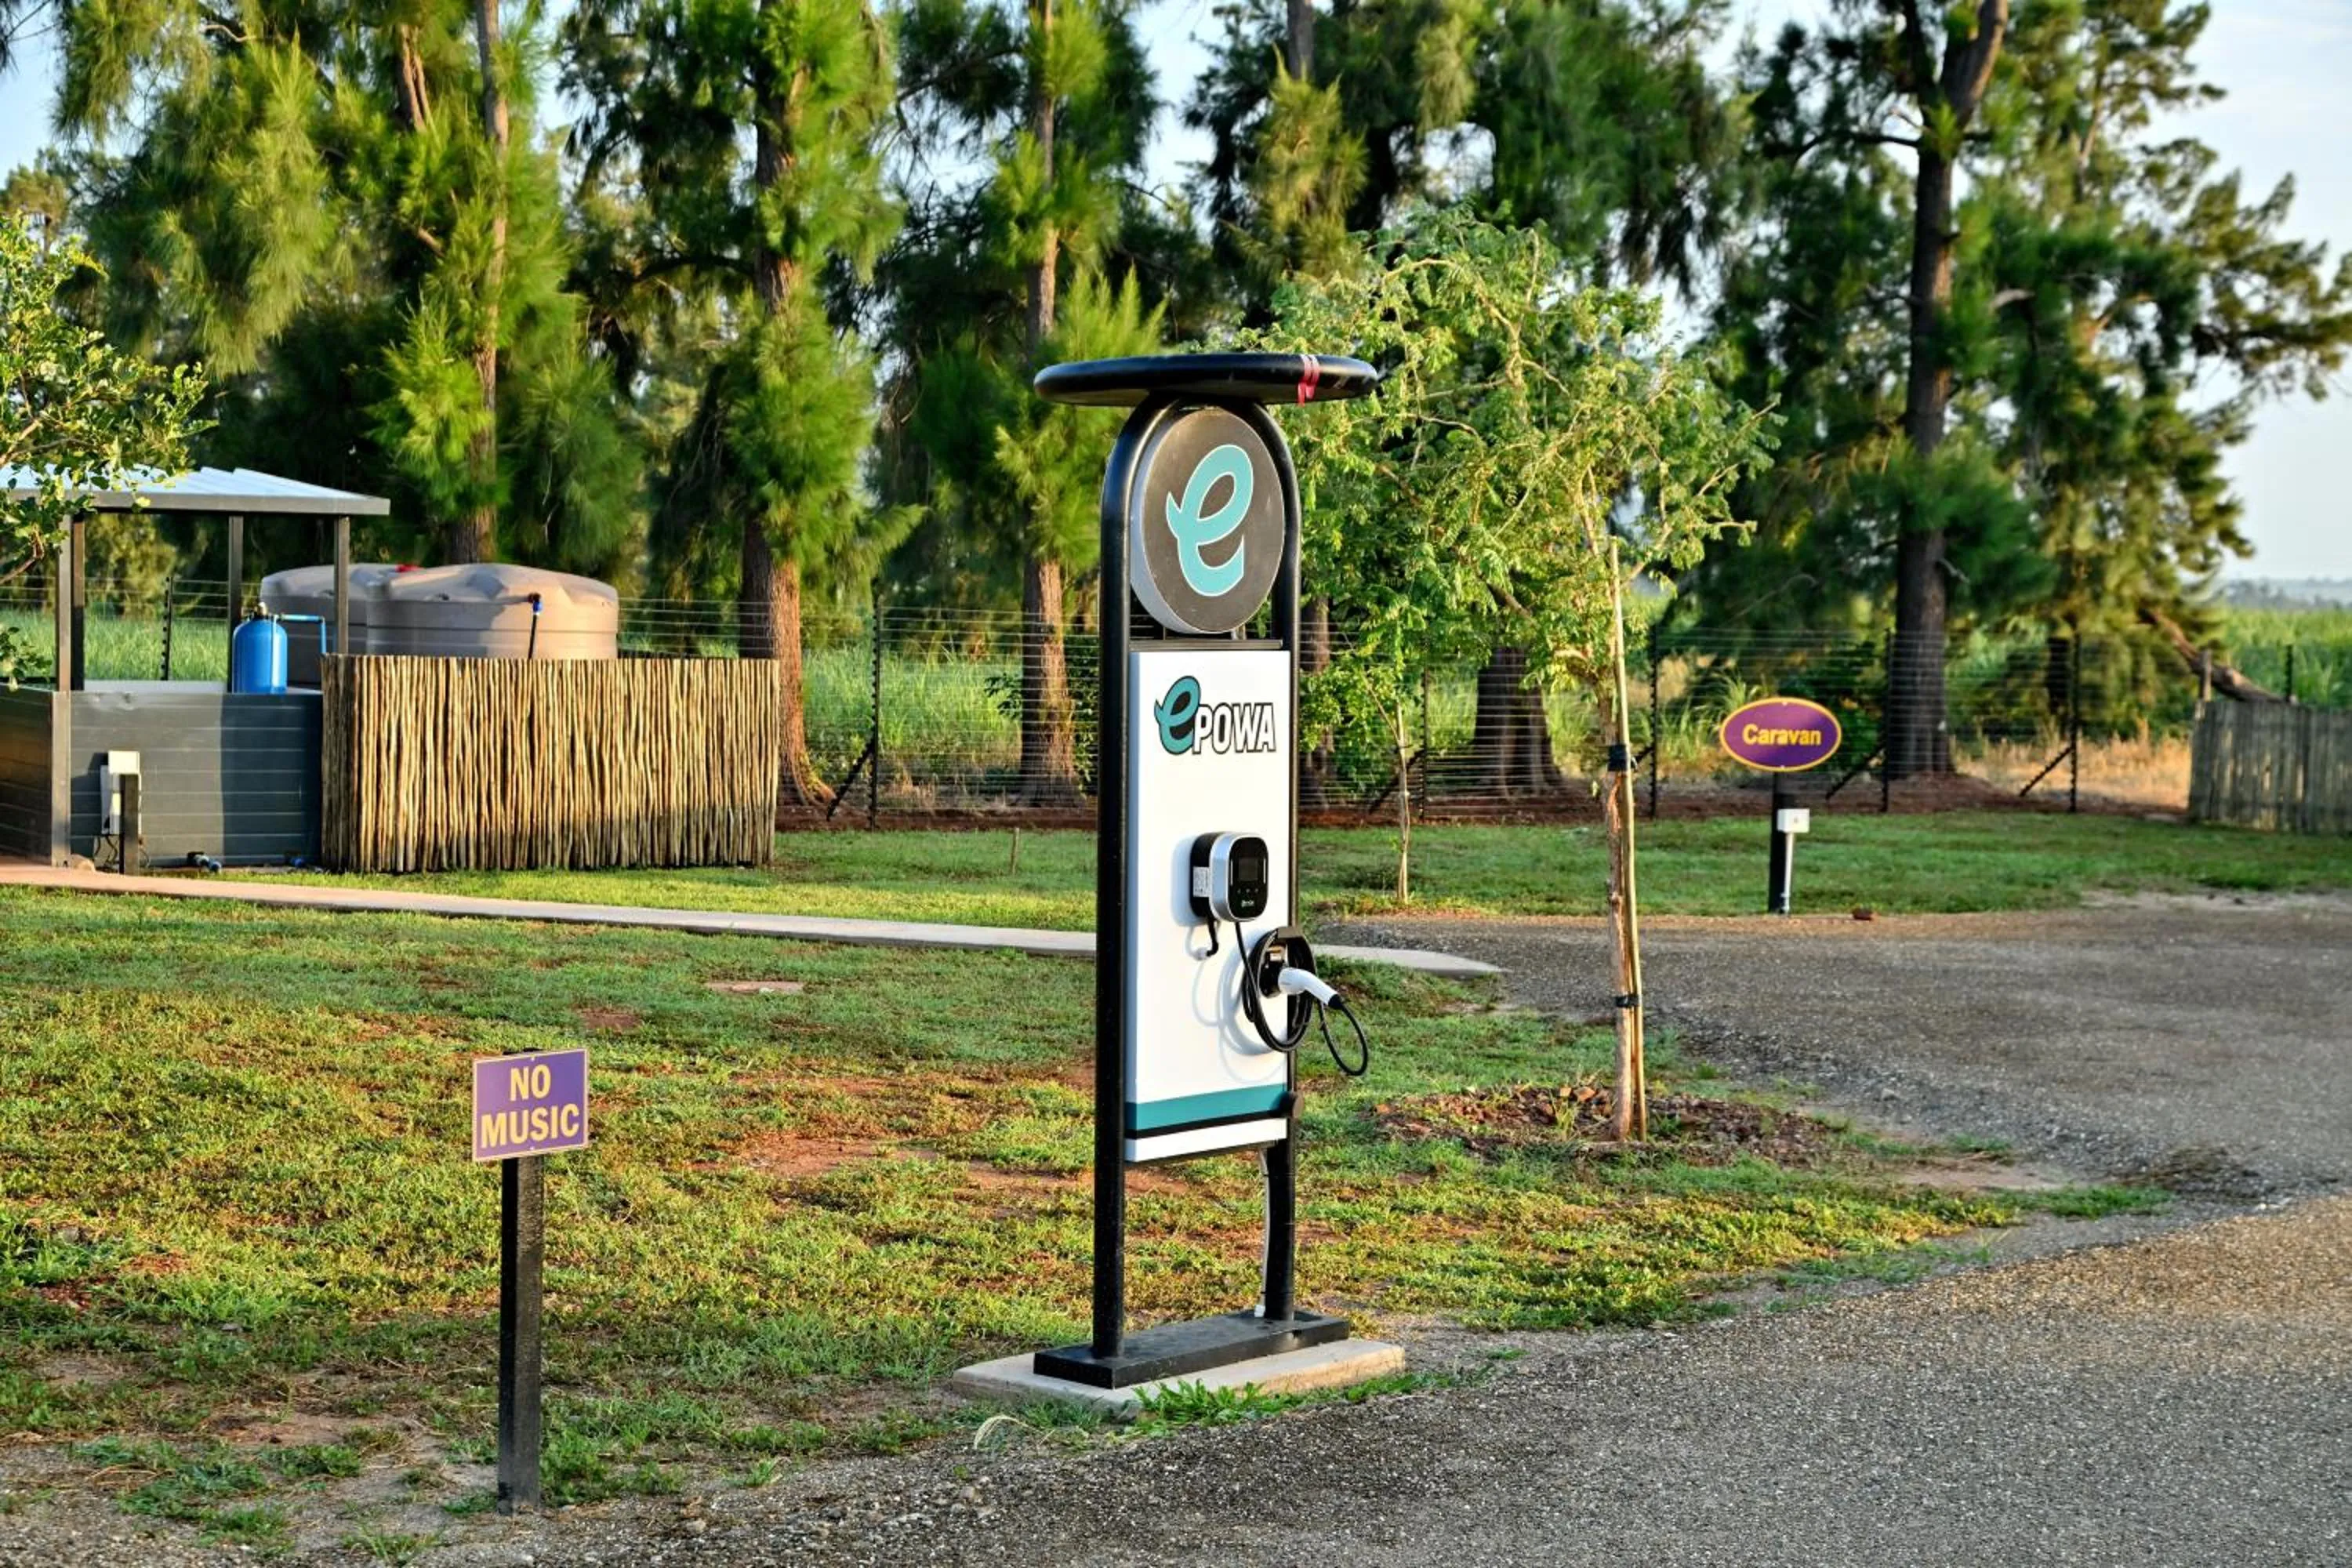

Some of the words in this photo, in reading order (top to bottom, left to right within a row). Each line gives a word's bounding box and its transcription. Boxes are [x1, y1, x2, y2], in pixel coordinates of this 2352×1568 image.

[1166, 445, 1254, 597] e
[1742, 723, 1822, 746] Caravan
[510, 1064, 551, 1102] NO
[481, 1103, 580, 1149] MUSIC
